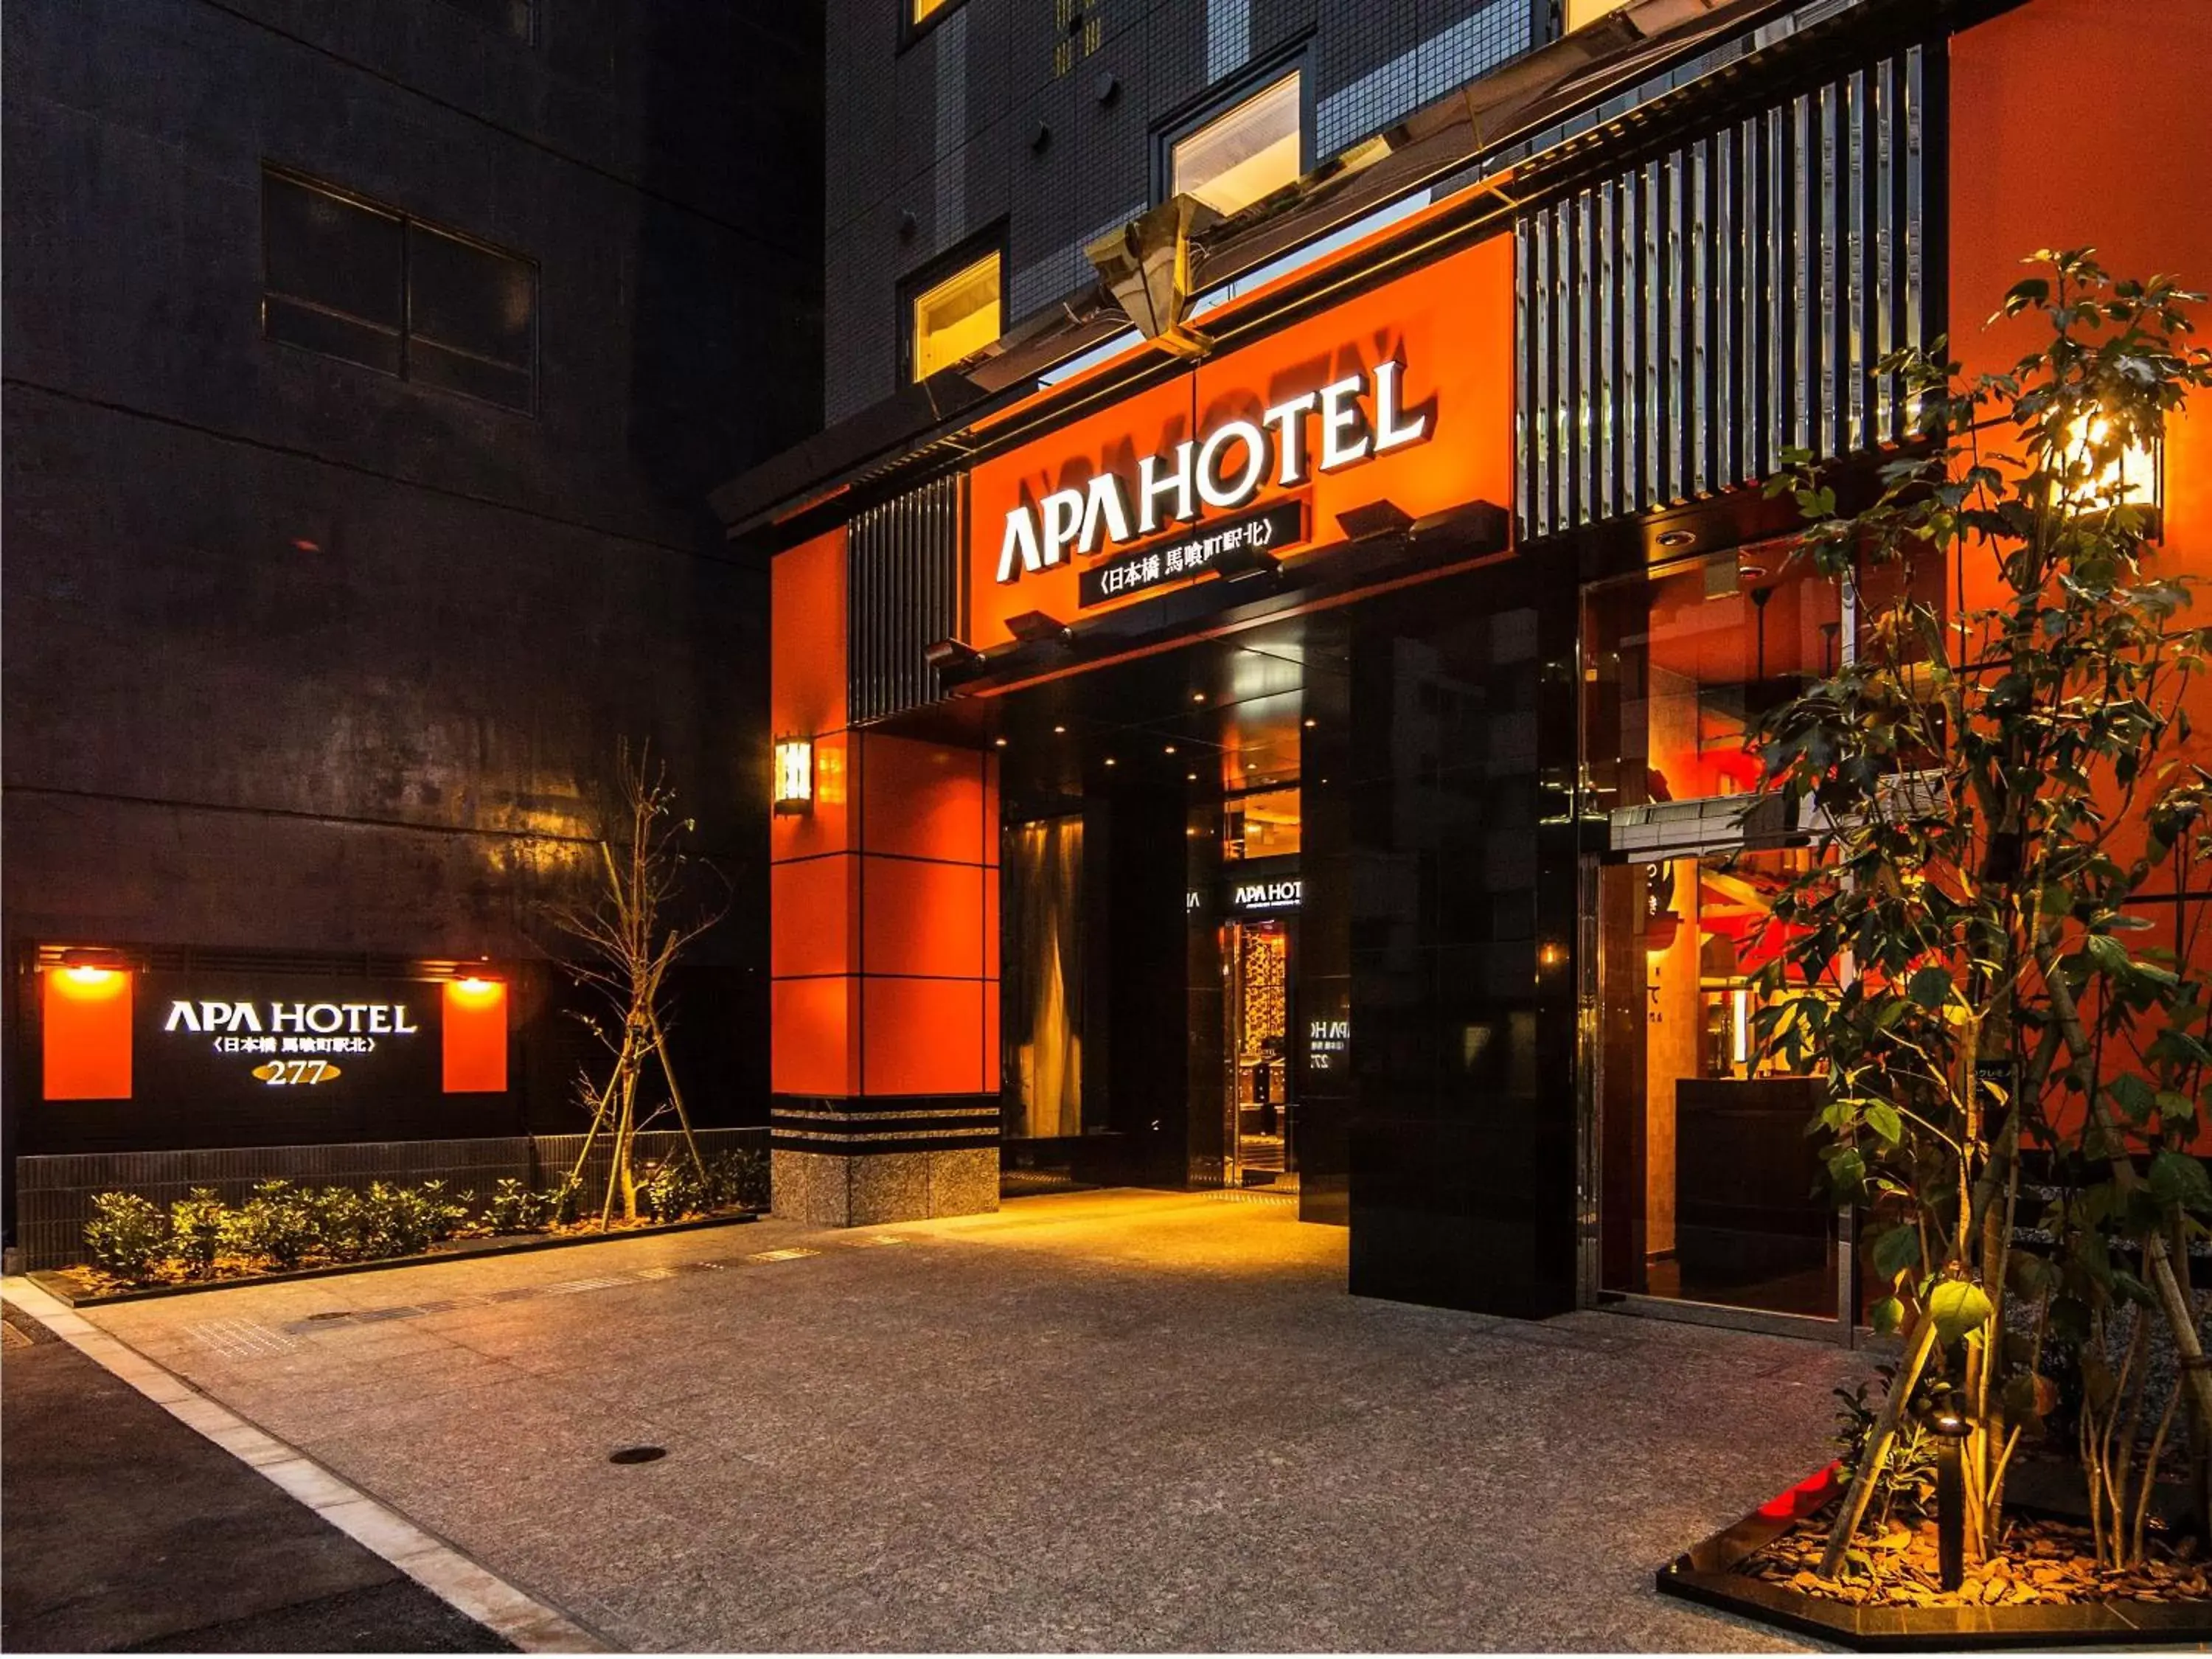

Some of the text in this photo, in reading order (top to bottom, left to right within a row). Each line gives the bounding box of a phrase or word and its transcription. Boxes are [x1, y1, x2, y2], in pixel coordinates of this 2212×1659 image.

[996, 361, 1428, 585] APA HOTEL
[1235, 887, 1266, 903] APA
[164, 1001, 418, 1033] APA HOTEL
[266, 1060, 329, 1085] 277
